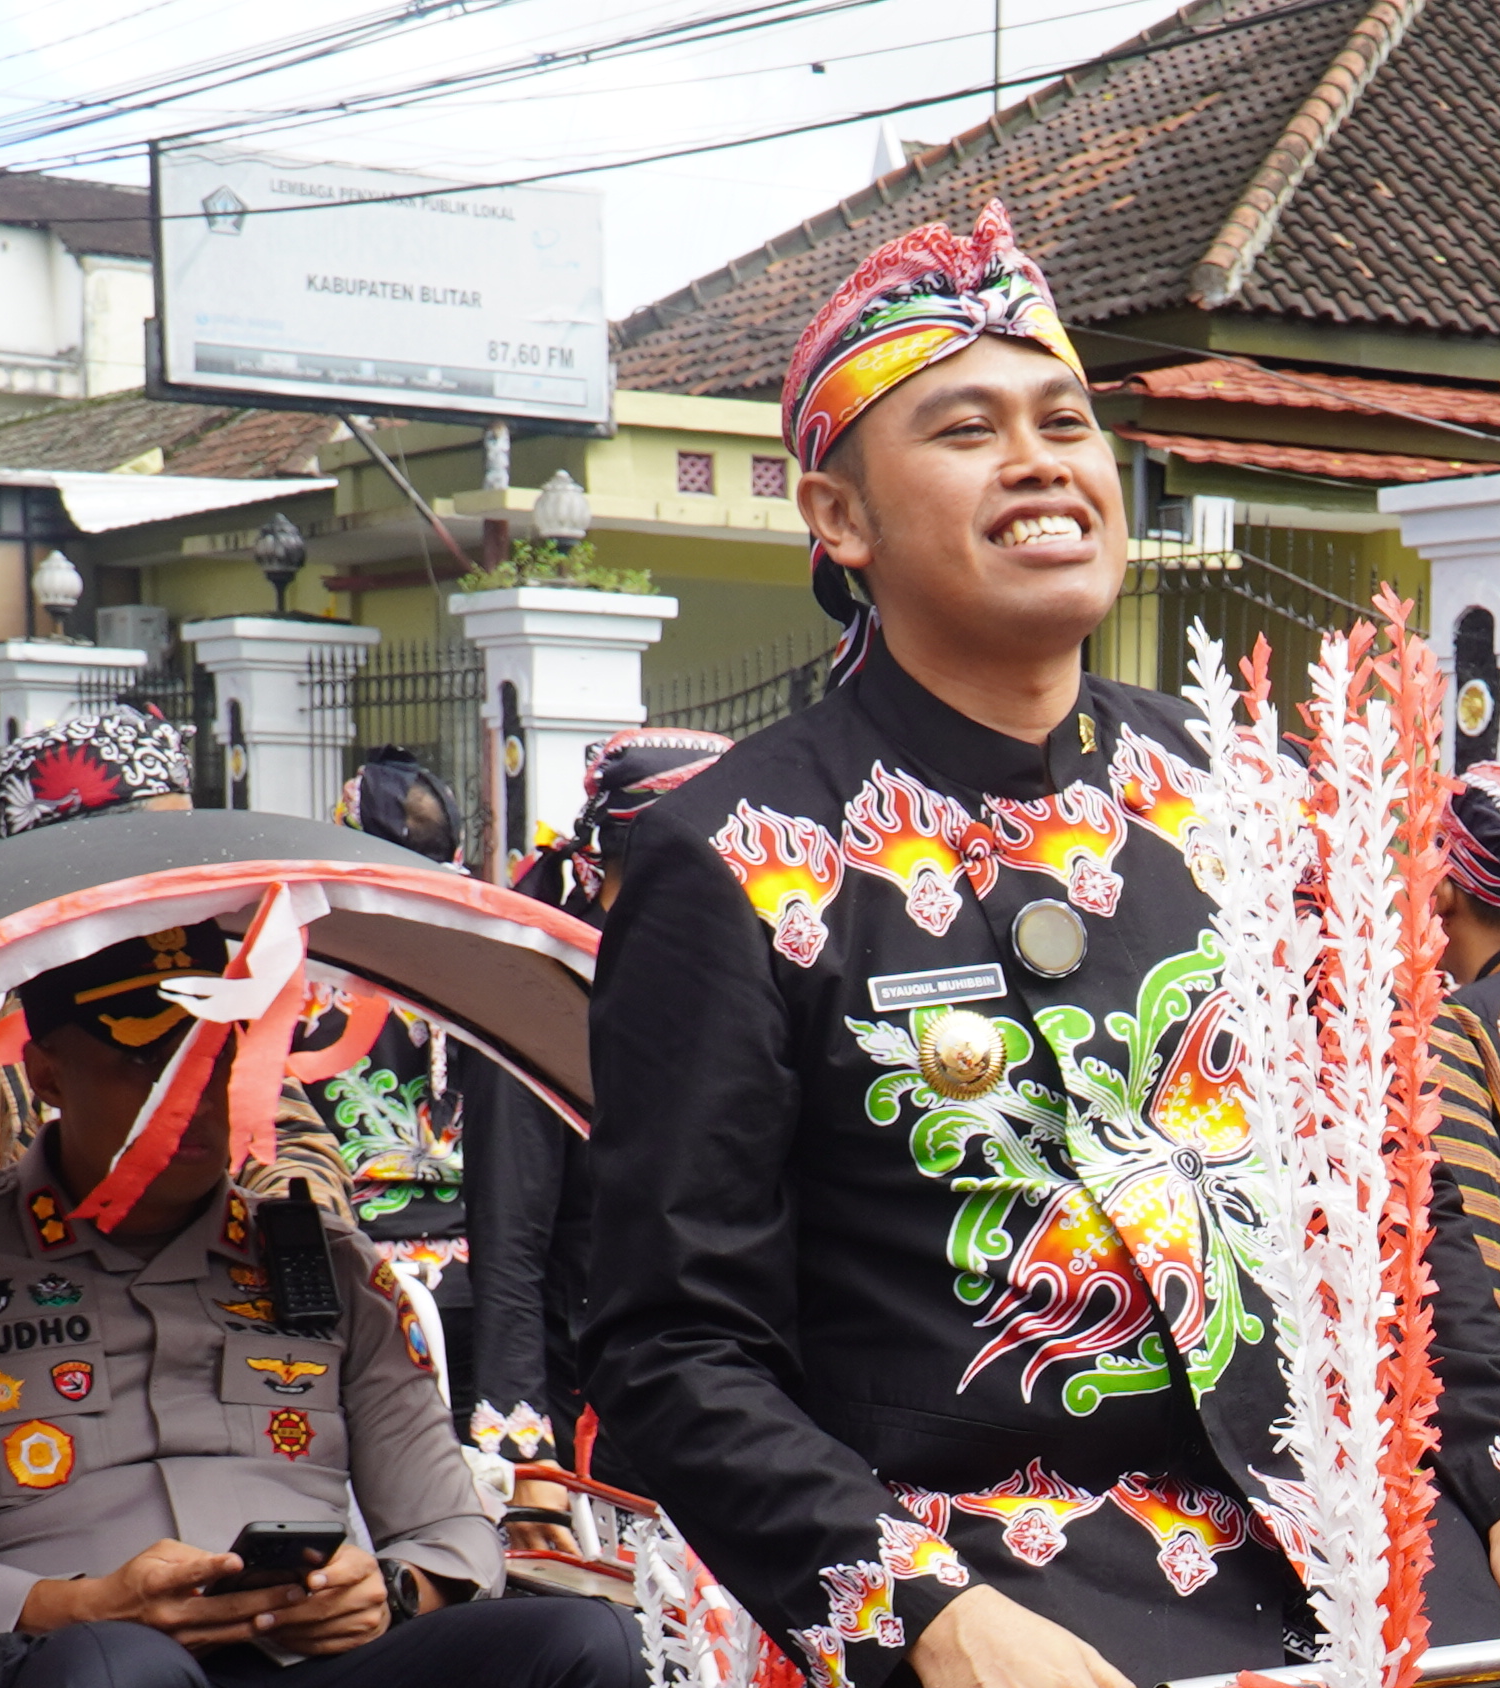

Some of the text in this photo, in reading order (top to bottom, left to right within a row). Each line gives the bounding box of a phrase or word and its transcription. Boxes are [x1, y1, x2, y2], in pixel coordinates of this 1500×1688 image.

[270, 178, 335, 199] LEMBAGA
[420, 198, 470, 216] PUBLIK
[472, 203, 516, 221] LOKAL
[305, 273, 483, 309] KABUPATEN BLITAR
[487, 340, 575, 370] 87,60 FM
[880, 974, 996, 999] SYAUQUL MUHIBBIN
